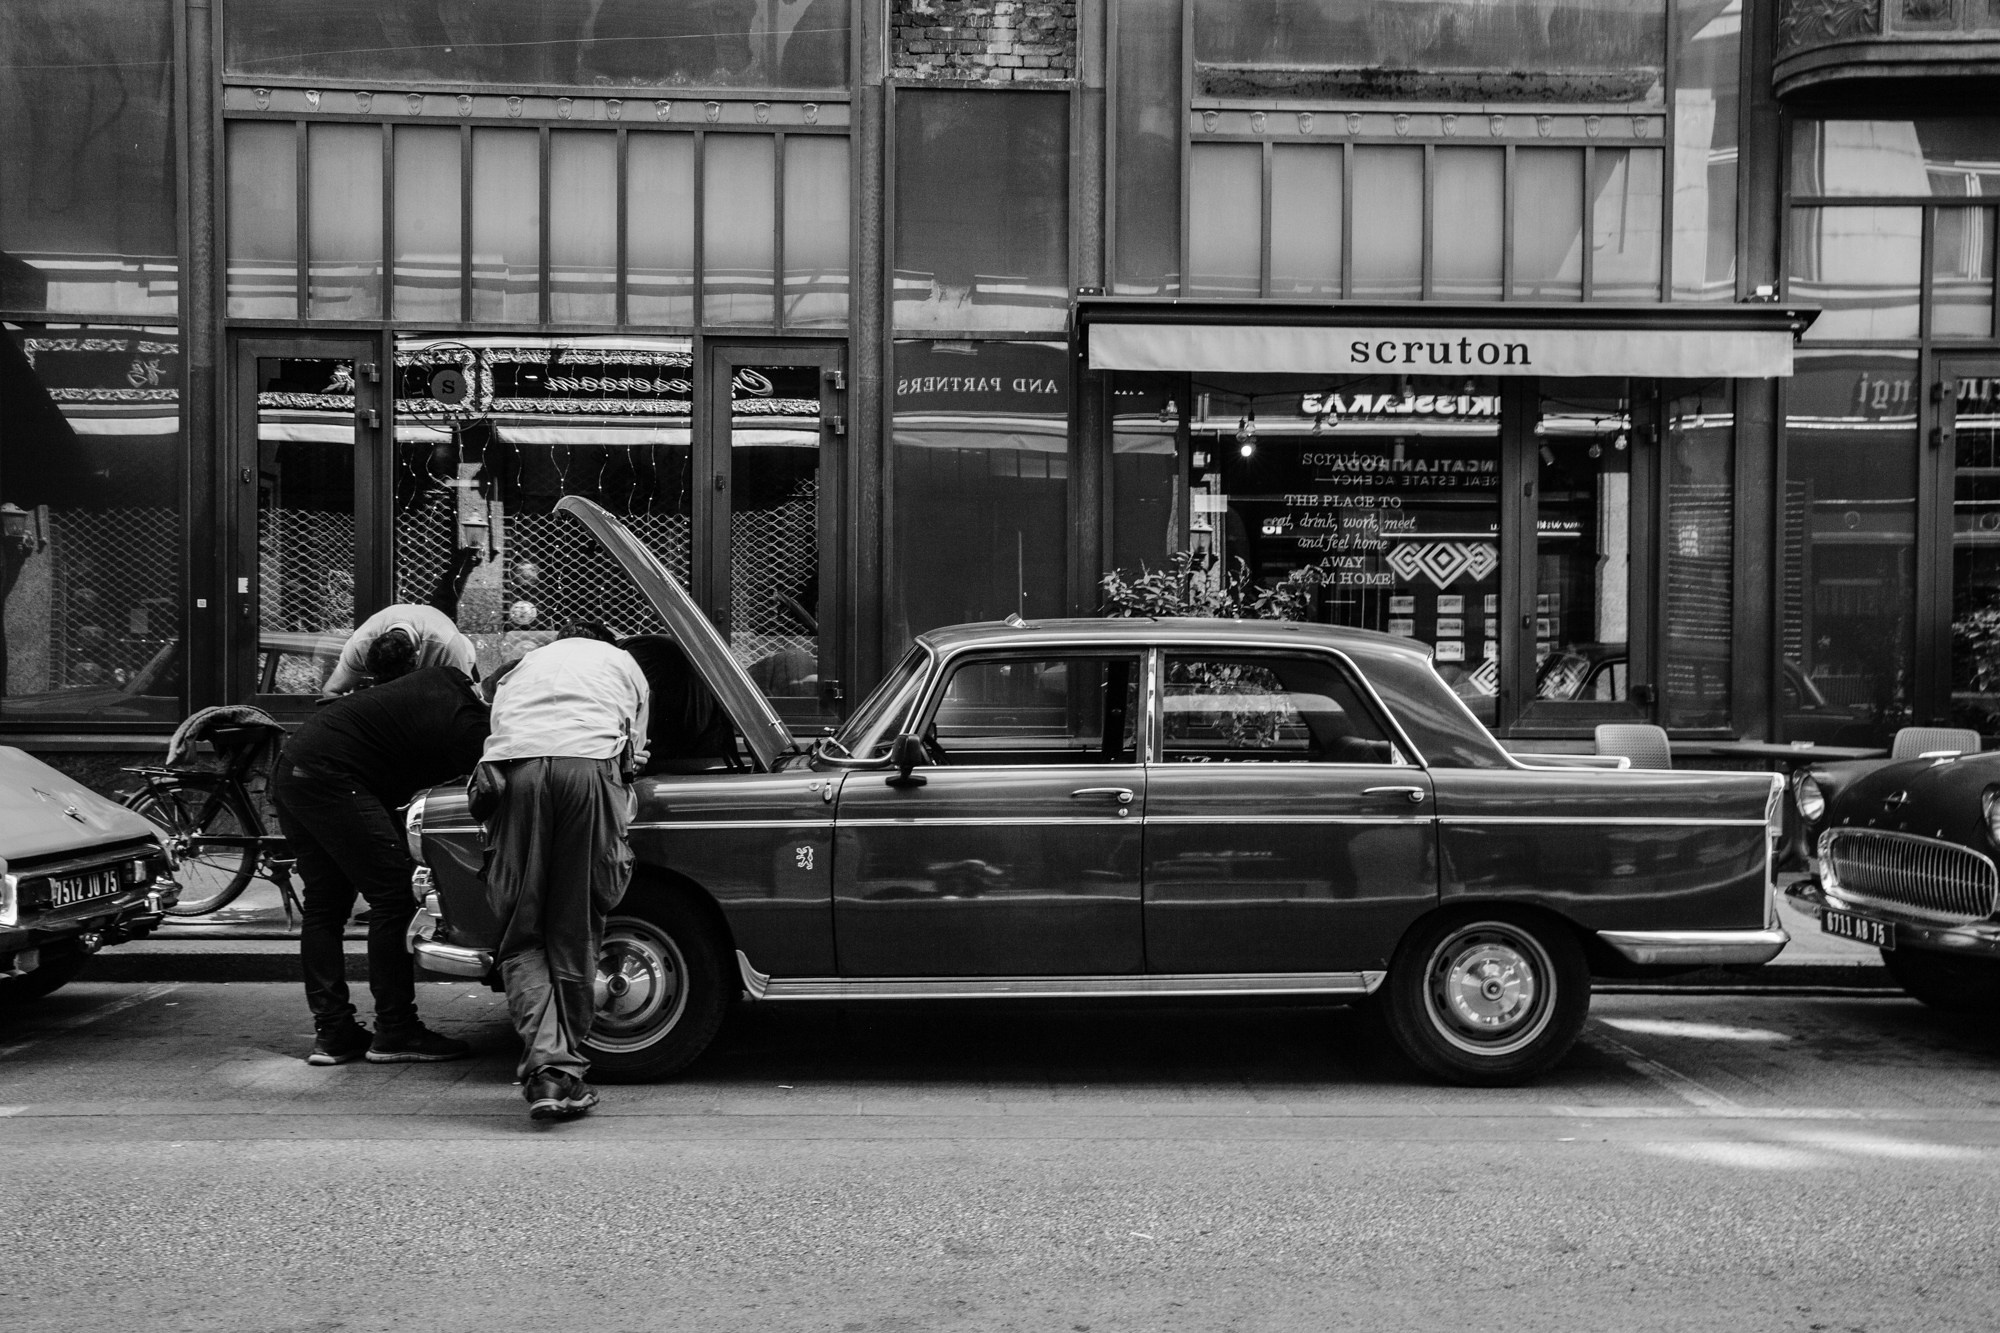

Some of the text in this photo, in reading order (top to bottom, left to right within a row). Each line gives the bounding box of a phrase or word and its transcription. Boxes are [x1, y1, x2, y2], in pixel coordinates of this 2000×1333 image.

[1350, 337, 1532, 365] scruton
[442, 380, 455, 394] S
[1302, 450, 1385, 466] scruton
[1284, 494, 1402, 508] THE PLACE TO
[1300, 512, 1338, 531] drink,
[1343, 513, 1380, 532] work,
[1384, 516, 1417, 530] meet
[1298, 533, 1388, 551] and feel home
[1320, 556, 1366, 568] AWAY
[1339, 571, 1396, 585] HOME!
[55, 870, 117, 905] 7512 JU 75
[1871, 922, 1885, 945] 75
